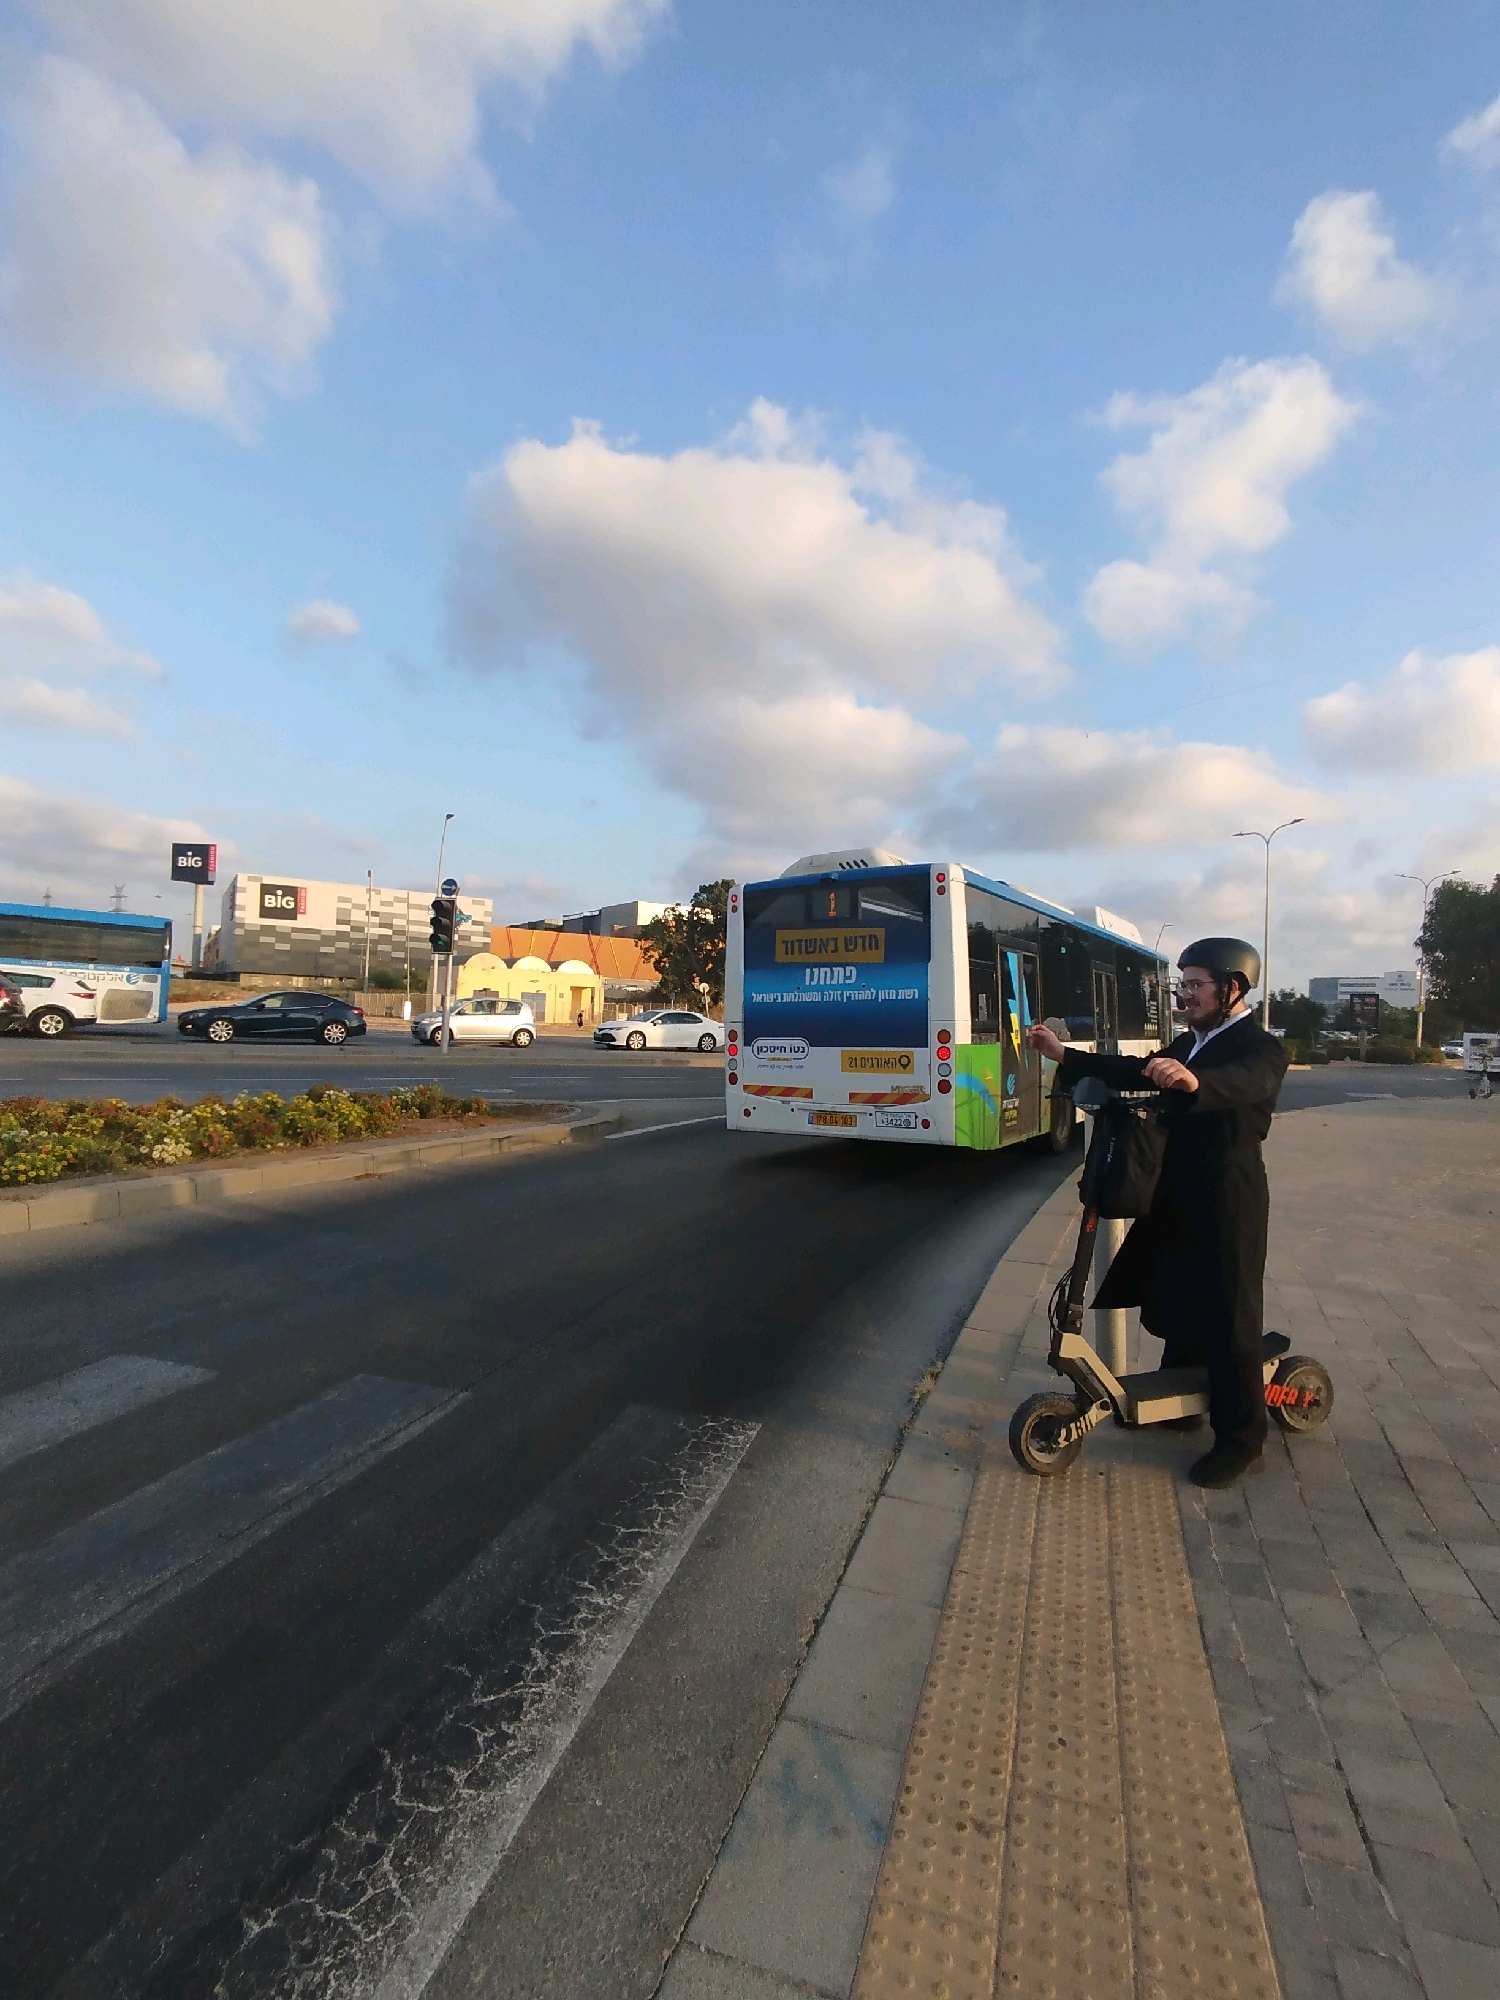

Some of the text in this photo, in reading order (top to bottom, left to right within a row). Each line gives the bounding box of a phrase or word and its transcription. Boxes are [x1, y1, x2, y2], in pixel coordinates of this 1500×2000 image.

[828, 891, 837, 918] 1
[782, 933, 880, 956] חדש באשדוד
[805, 965, 858, 986] פתחנו
[752, 992, 781, 1003] בישראל
[823, 989, 842, 1002] זולה
[843, 988, 876, 1003] למהדרין
[878, 989, 896, 1003] מזון
[898, 988, 919, 1000] רשת
[756, 1044, 806, 1055] נטו חיסכון
[847, 1056, 897, 1070] האורגים 21
